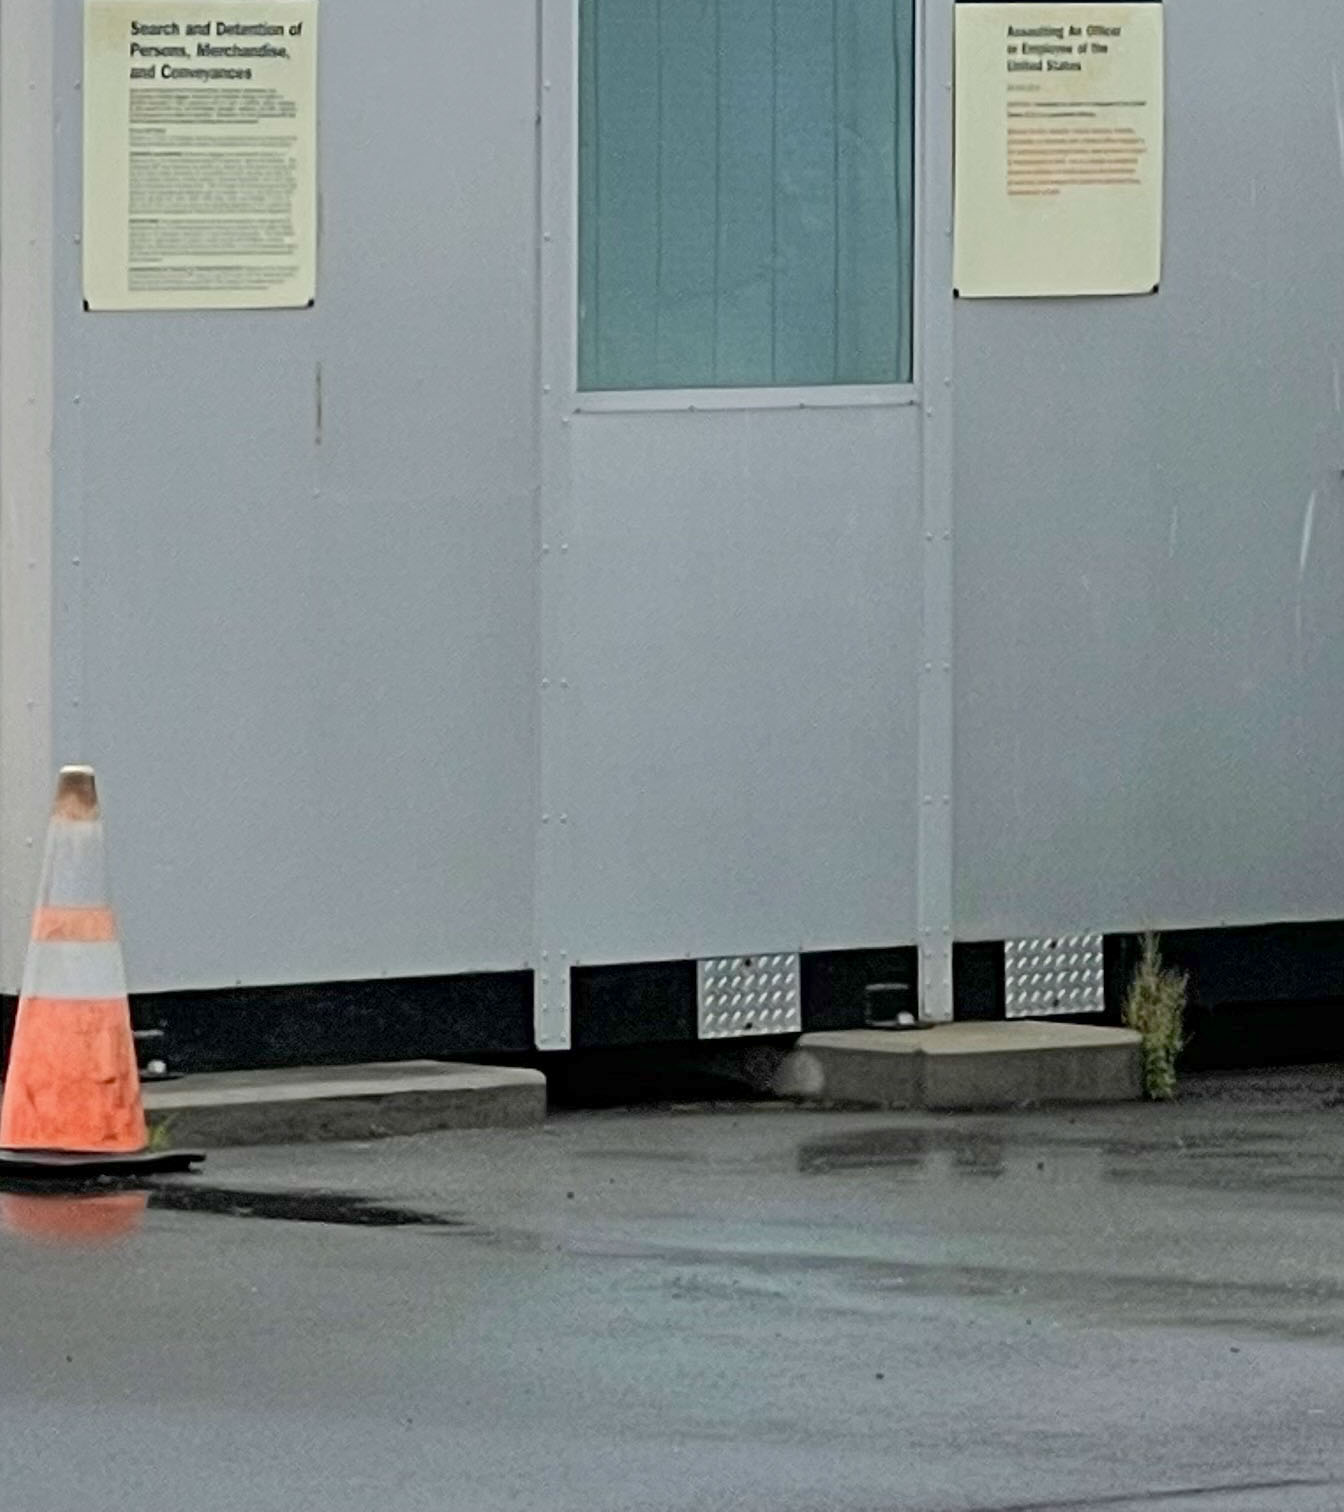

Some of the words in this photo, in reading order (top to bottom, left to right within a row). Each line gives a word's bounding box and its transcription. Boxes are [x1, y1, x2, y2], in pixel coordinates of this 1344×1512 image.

[130, 20, 180, 36] Search
[185, 20, 211, 36] and
[216, 21, 284, 36] Detention
[288, 21, 303, 36] of
[130, 64, 156, 79] and
